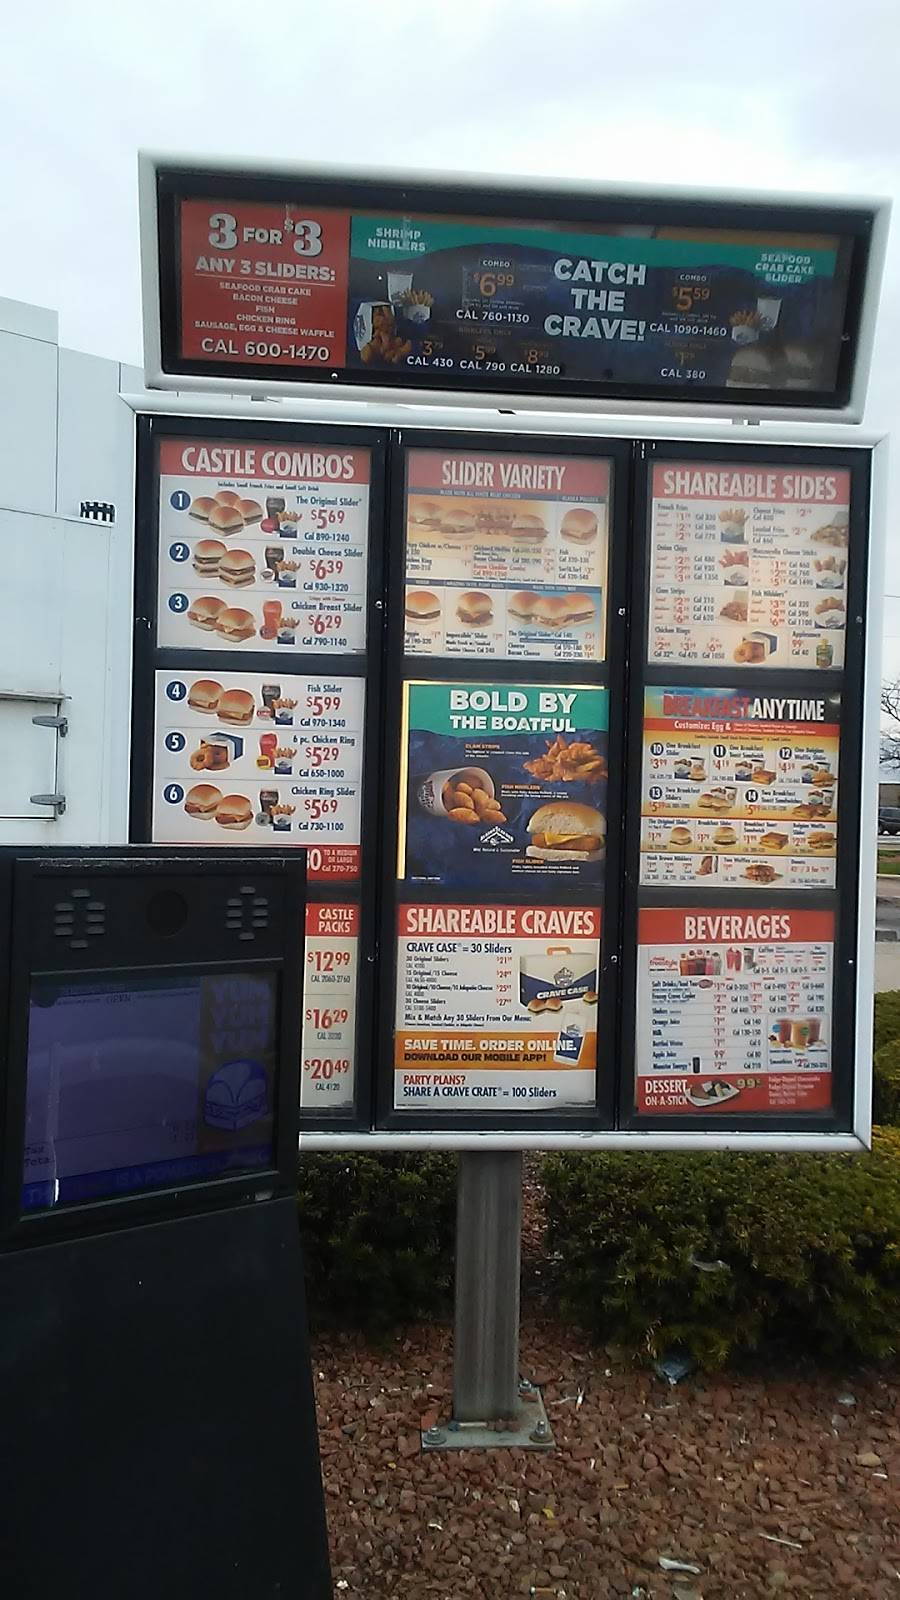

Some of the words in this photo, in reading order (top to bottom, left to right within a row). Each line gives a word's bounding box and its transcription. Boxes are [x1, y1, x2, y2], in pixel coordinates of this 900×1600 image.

[209, 213, 238, 249] 3
[243, 228, 282, 245] FOR
[376, 228, 421, 238] SHRIMP
[368, 239, 426, 251] NIBBLERS
[483, 260, 510, 268] COMBO
[761, 253, 810, 263] SEAFOOD
[195, 256, 233, 273] ANY
[241, 260, 251, 275] 3
[256, 262, 336, 281] SLIDERS:
[553, 258, 646, 286] CATCH
[755, 263, 784, 272] CRAB
[787, 265, 814, 275] CAKE
[765, 274, 801, 283] SLIDER
[219, 282, 261, 292] SEAFOOD
[263, 285, 286, 294] CRAB
[288, 287, 312, 296] CAKE
[233, 293, 263, 301] BACON
[266, 295, 298, 304] CHEESE
[571, 288, 625, 312] THE
[256, 305, 275, 313] FISH
[236, 313, 273, 323] CHICKEN
[275, 316, 296, 325] RING
[456, 309, 479, 321] CAL
[482, 311, 529, 323] 760-1130
[195, 320, 238, 331] SAUSAGE,
[240, 323, 256, 332] EGG
[258, 325, 264, 333] &
[266, 325, 299, 336] CHEESE
[300, 328, 335, 338] WAFFLE
[544, 315, 646, 341] CRAVE!
[650, 323, 670, 333] CAL
[675, 325, 726, 336] 1090-1460
[201, 338, 241, 354] CAL
[245, 341, 329, 361] 600-1470
[407, 356, 429, 366] CAL
[432, 358, 453, 367] 430
[460, 360, 481, 370] CAL
[486, 362, 505, 371] 790
[511, 364, 531, 373] CAL
[536, 365, 560, 374] 1280
[661, 368, 681, 378] CAL
[686, 370, 705, 379] 380
[182, 447, 255, 475] CASTLE
[261, 451, 354, 479] COMBOS
[442, 460, 494, 487] SLIDER
[500, 463, 565, 490] VARIETY
[664, 471, 776, 498] SHAREABLE
[782, 475, 836, 500] SIDES
[296, 496, 309, 505] The
[310, 497, 337, 507] Original
[305, 533, 314, 541] Cal
[316, 533, 349, 542] 890-1240
[292, 547, 315, 556] Double
[317, 548, 342, 557] Cheese
[344, 549, 363, 558] Slider
[304, 582, 313, 590] Cal
[315, 583, 348, 592] 930-1320
[292, 601, 316, 610] Chicken
[319, 603, 341, 611] Breast
[344, 604, 362, 612] Slider
[303, 637, 312, 645] Cal
[314, 637, 347, 646] 790-1140
[307, 684, 321, 693] Fish
[323, 685, 342, 693] Slider
[450, 690, 528, 712] BOLD
[539, 692, 576, 714] BY
[752, 698, 825, 721] ANYTIME
[312, 719, 346, 727] 970-1340
[450, 715, 486, 730] THE
[492, 716, 575, 733] BOATFUL
[674, 720, 710, 731] Customize:
[712, 721, 724, 732] Egg
[725, 722, 731, 731] &
[293, 735, 298, 743] 6
[312, 735, 337, 744] Chicken
[340, 737, 355, 746] Ring
[300, 769, 309, 777] Cal
[311, 770, 345, 778] 650-1000
[292, 787, 317, 795] Chicken
[319, 788, 335, 797] Ring
[337, 788, 355, 796] Slider
[299, 822, 308, 830] Cal
[310, 823, 344, 831] 730-1100
[319, 908, 354, 920] CASTLE
[319, 921, 350, 933] PACKS
[407, 909, 516, 934] SHAREABLE
[521, 910, 594, 935] CRAVES
[685, 915, 790, 940] BEVERAGES
[407, 943, 434, 953] CRAVE
[471, 944, 482, 953] 30
[484, 944, 512, 954] Sliders
[537, 988, 566, 1000] CRAVE
[567, 986, 589, 995] CASE
[443, 1015, 454, 1023] Any
[404, 1039, 438, 1051] SAVE
[441, 1040, 476, 1051] TIME.
[480, 1040, 524, 1051] ORDER
[528, 1040, 577, 1051] ONLINE.
[404, 1053, 459, 1061] DOWNLOAD
[484, 1054, 520, 1062] MOBILE
[523, 1054, 546, 1062] APP!
[404, 1075, 431, 1085] PARTY
[434, 1075, 466, 1085] PLANS?
[404, 1087, 432, 1097] SHARE
[434, 1087, 440, 1097] A
[443, 1087, 469, 1097] CRAVE
[512, 1088, 527, 1097] 100
[529, 1087, 557, 1097] Sliders
[645, 1079, 687, 1094] DESSERT
